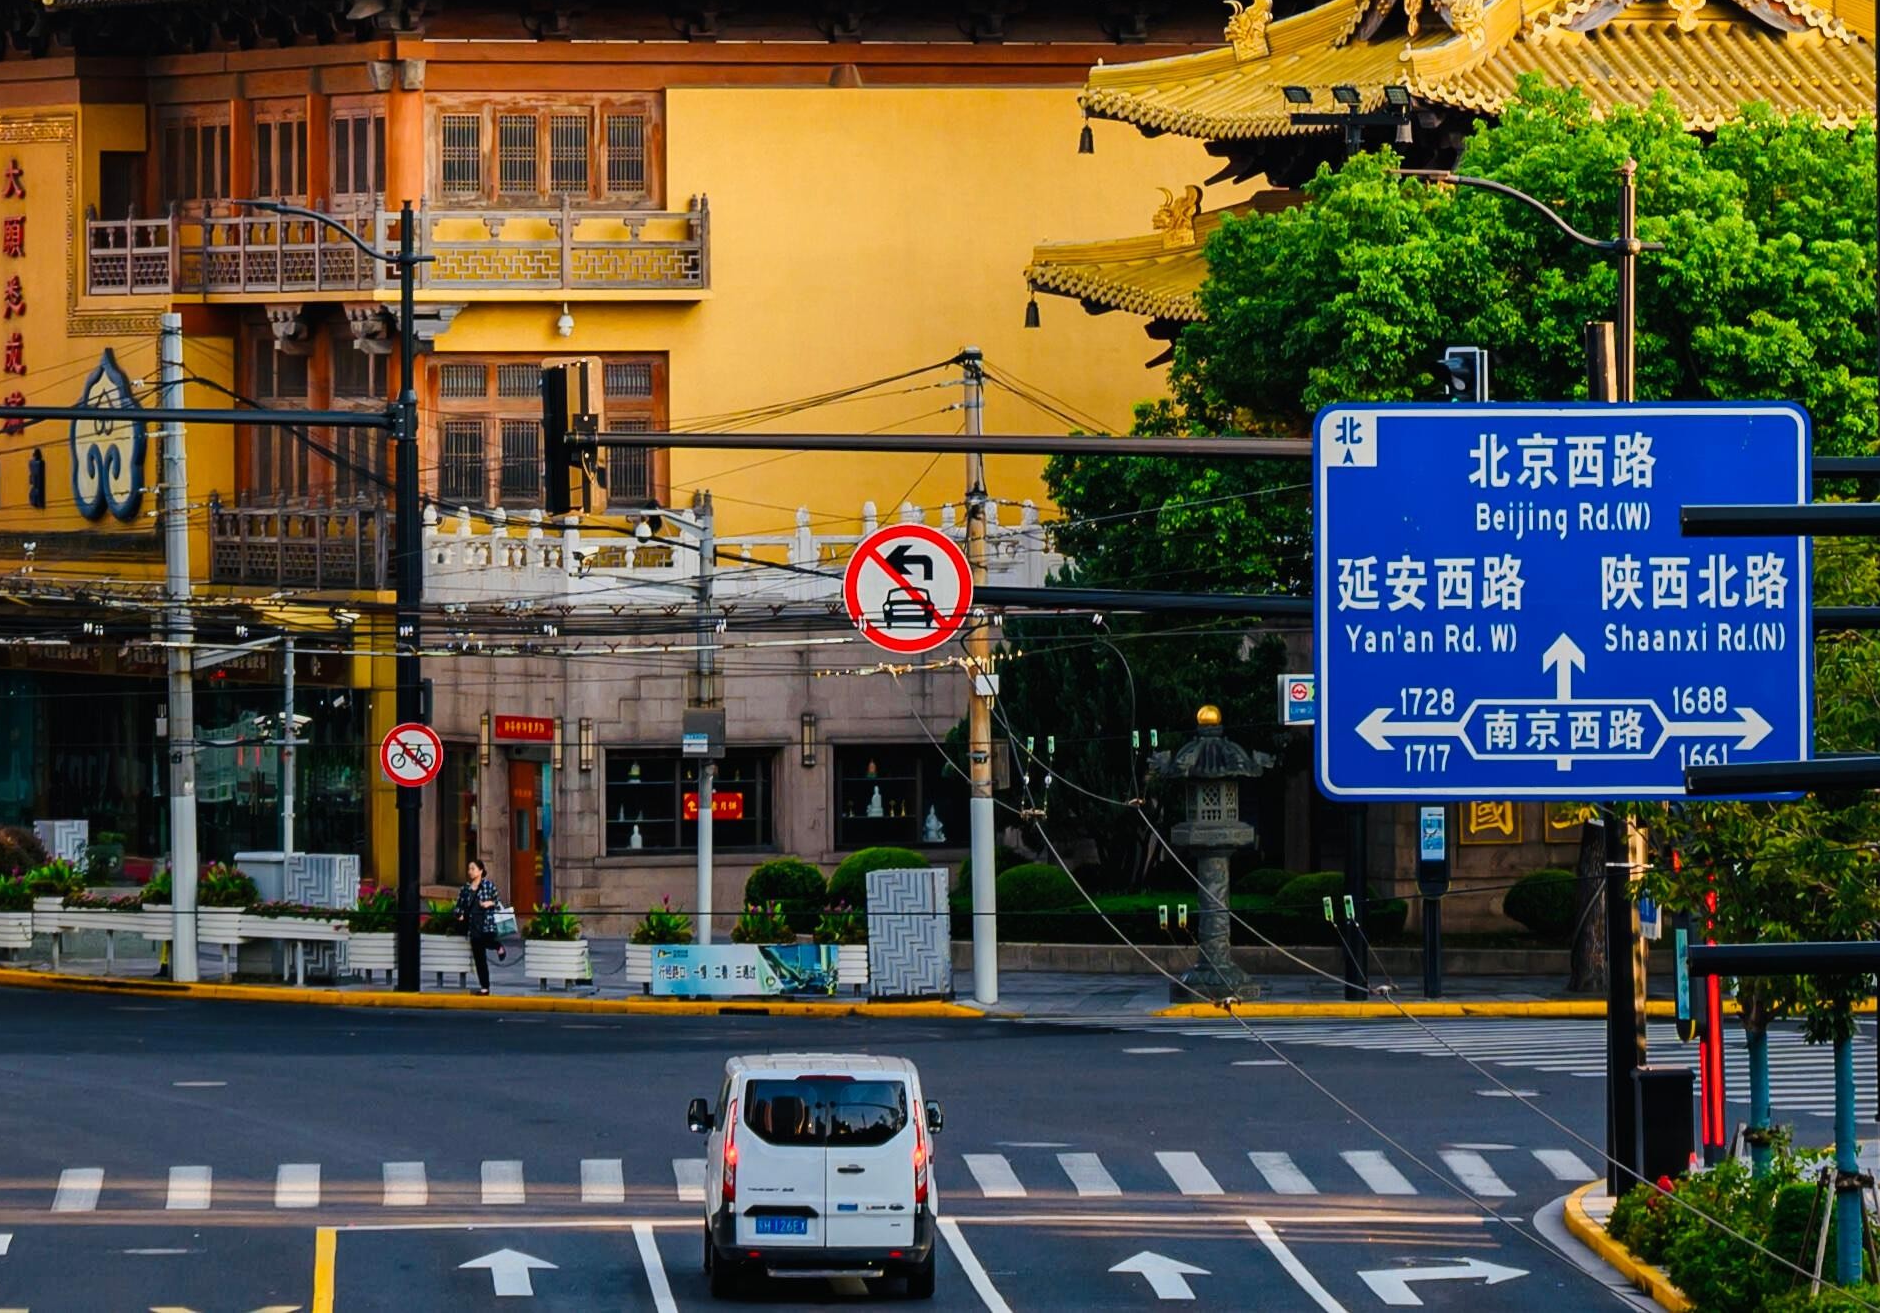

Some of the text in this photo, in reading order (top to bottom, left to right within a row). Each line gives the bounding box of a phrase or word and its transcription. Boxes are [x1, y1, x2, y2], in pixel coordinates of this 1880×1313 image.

[1334, 416, 1363, 445] 北
[1469, 432, 1656, 489] 北京西路
[1477, 503, 1651, 539] Beijing Rd.(W)
[1337, 554, 1525, 611] 延安西路
[1602, 553, 1788, 610] 陕西北路
[1345, 625, 1433, 652] Yan'an
[1605, 623, 1785, 652] Shaanxi Rd.(N)
[1401, 687, 1455, 715] 1728
[1673, 686, 1727, 714] 1688
[1484, 709, 1644, 750] 南京西路
[1405, 744, 1451, 772] 1717
[1679, 743, 1728, 771] 1661
